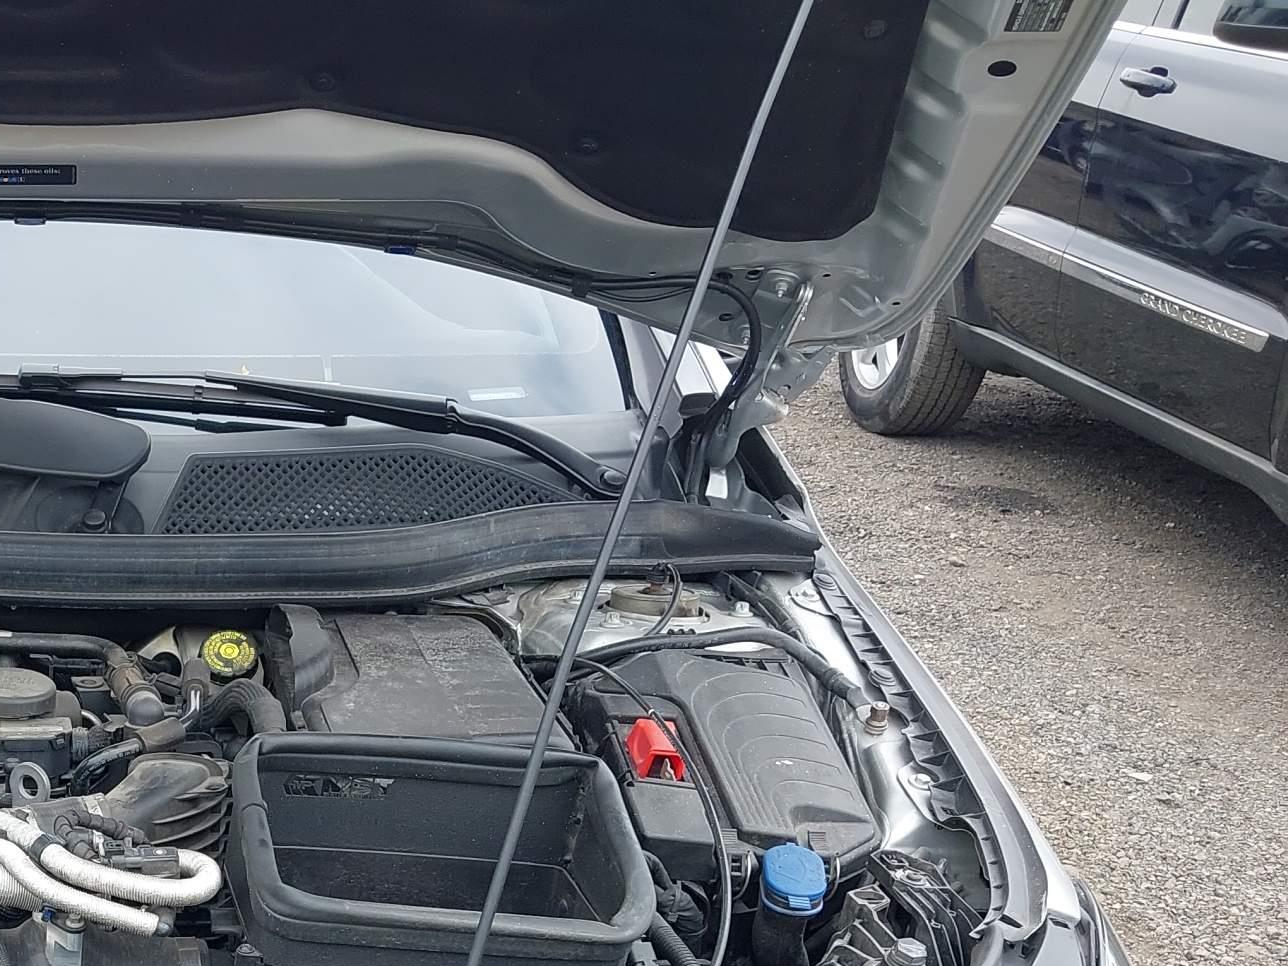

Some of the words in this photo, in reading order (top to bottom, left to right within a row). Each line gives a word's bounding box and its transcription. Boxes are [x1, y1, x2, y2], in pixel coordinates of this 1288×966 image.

[21, 167, 43, 175] these
[1140, 292, 1179, 316] GRAND
[1182, 309, 1247, 344] CHEROKEE
